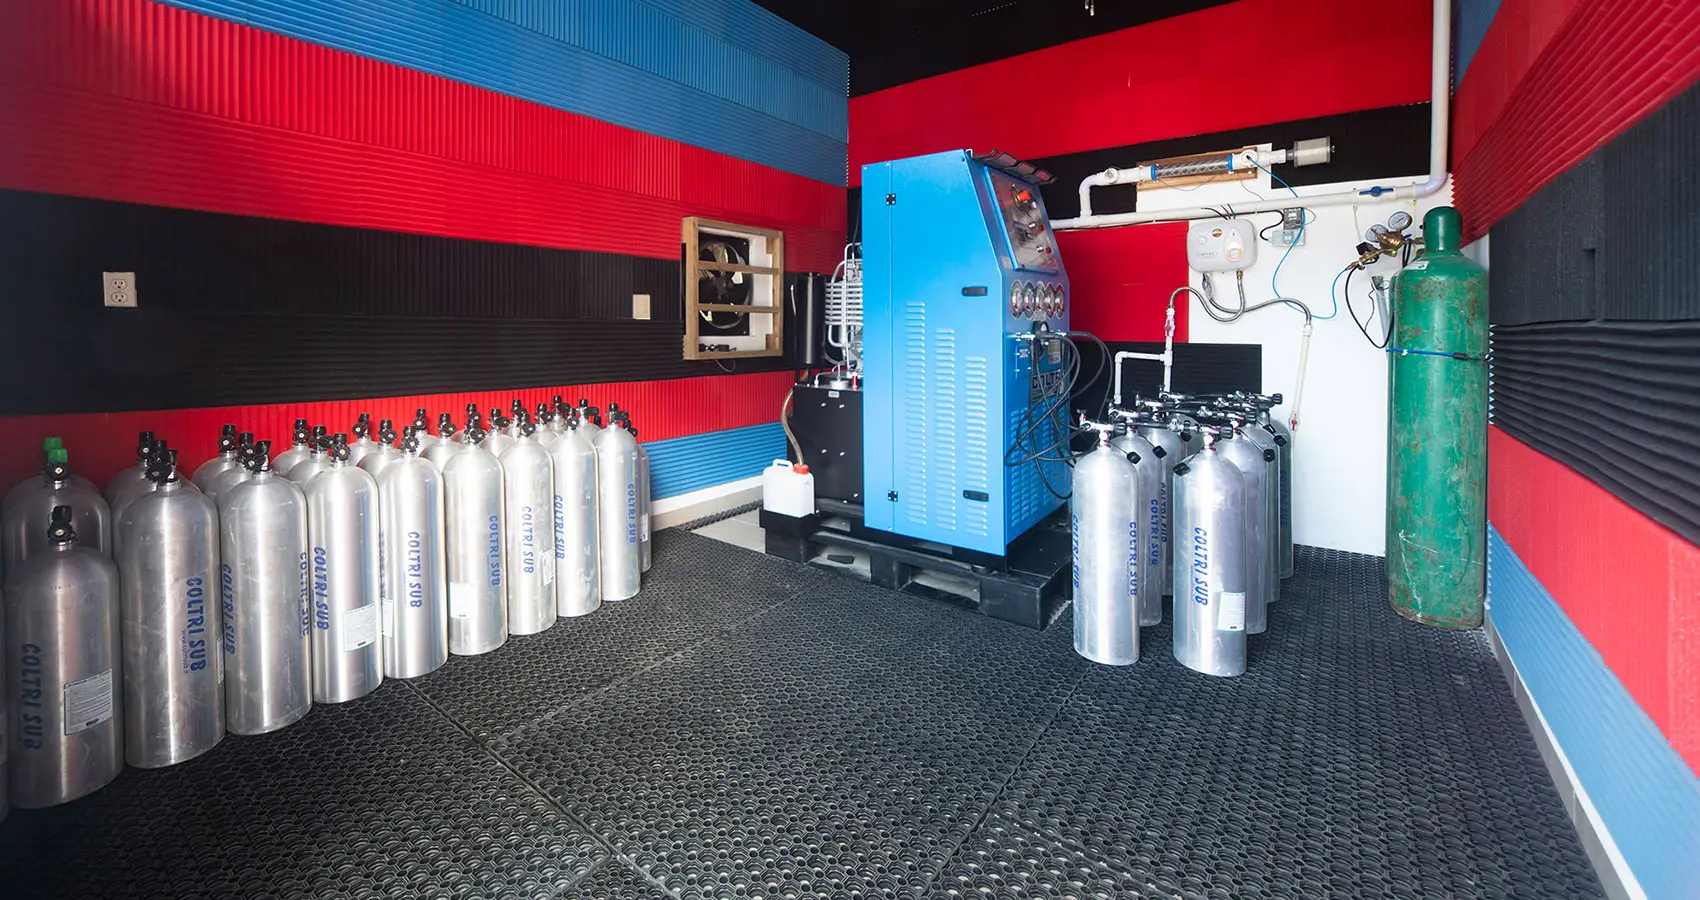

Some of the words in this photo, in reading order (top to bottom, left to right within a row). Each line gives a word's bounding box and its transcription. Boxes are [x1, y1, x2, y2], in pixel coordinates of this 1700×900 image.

[554, 494, 564, 538] COLTRI
[628, 483, 636, 521] COLTRI
[1151, 498, 1159, 539] COLTRI
[489, 515, 499, 558] COLTRI
[522, 506, 533, 547] COLTRI
[628, 523, 637, 543] SUB
[1128, 521, 1137, 566] COLTRI
[408, 531, 421, 577] COLTRI
[523, 551, 534, 573] SUB
[555, 540, 565, 559] SUB
[1151, 543, 1160, 565] SUB
[1194, 527, 1208, 578] COLTRI
[314, 546, 327, 597] COLTRI
[491, 562, 500, 585] SUB
[1129, 571, 1138, 596] SUB
[186, 577, 204, 634] COLTRI
[222, 563, 234, 619] COLTRI
[409, 582, 422, 608] SUB
[1195, 577, 1208, 606] SUB
[316, 601, 329, 630] SUB
[189, 639, 206, 671] SUB
[224, 622, 235, 654] SUB
[22, 643, 41, 707] COLTRI
[23, 714, 42, 749] SUB
